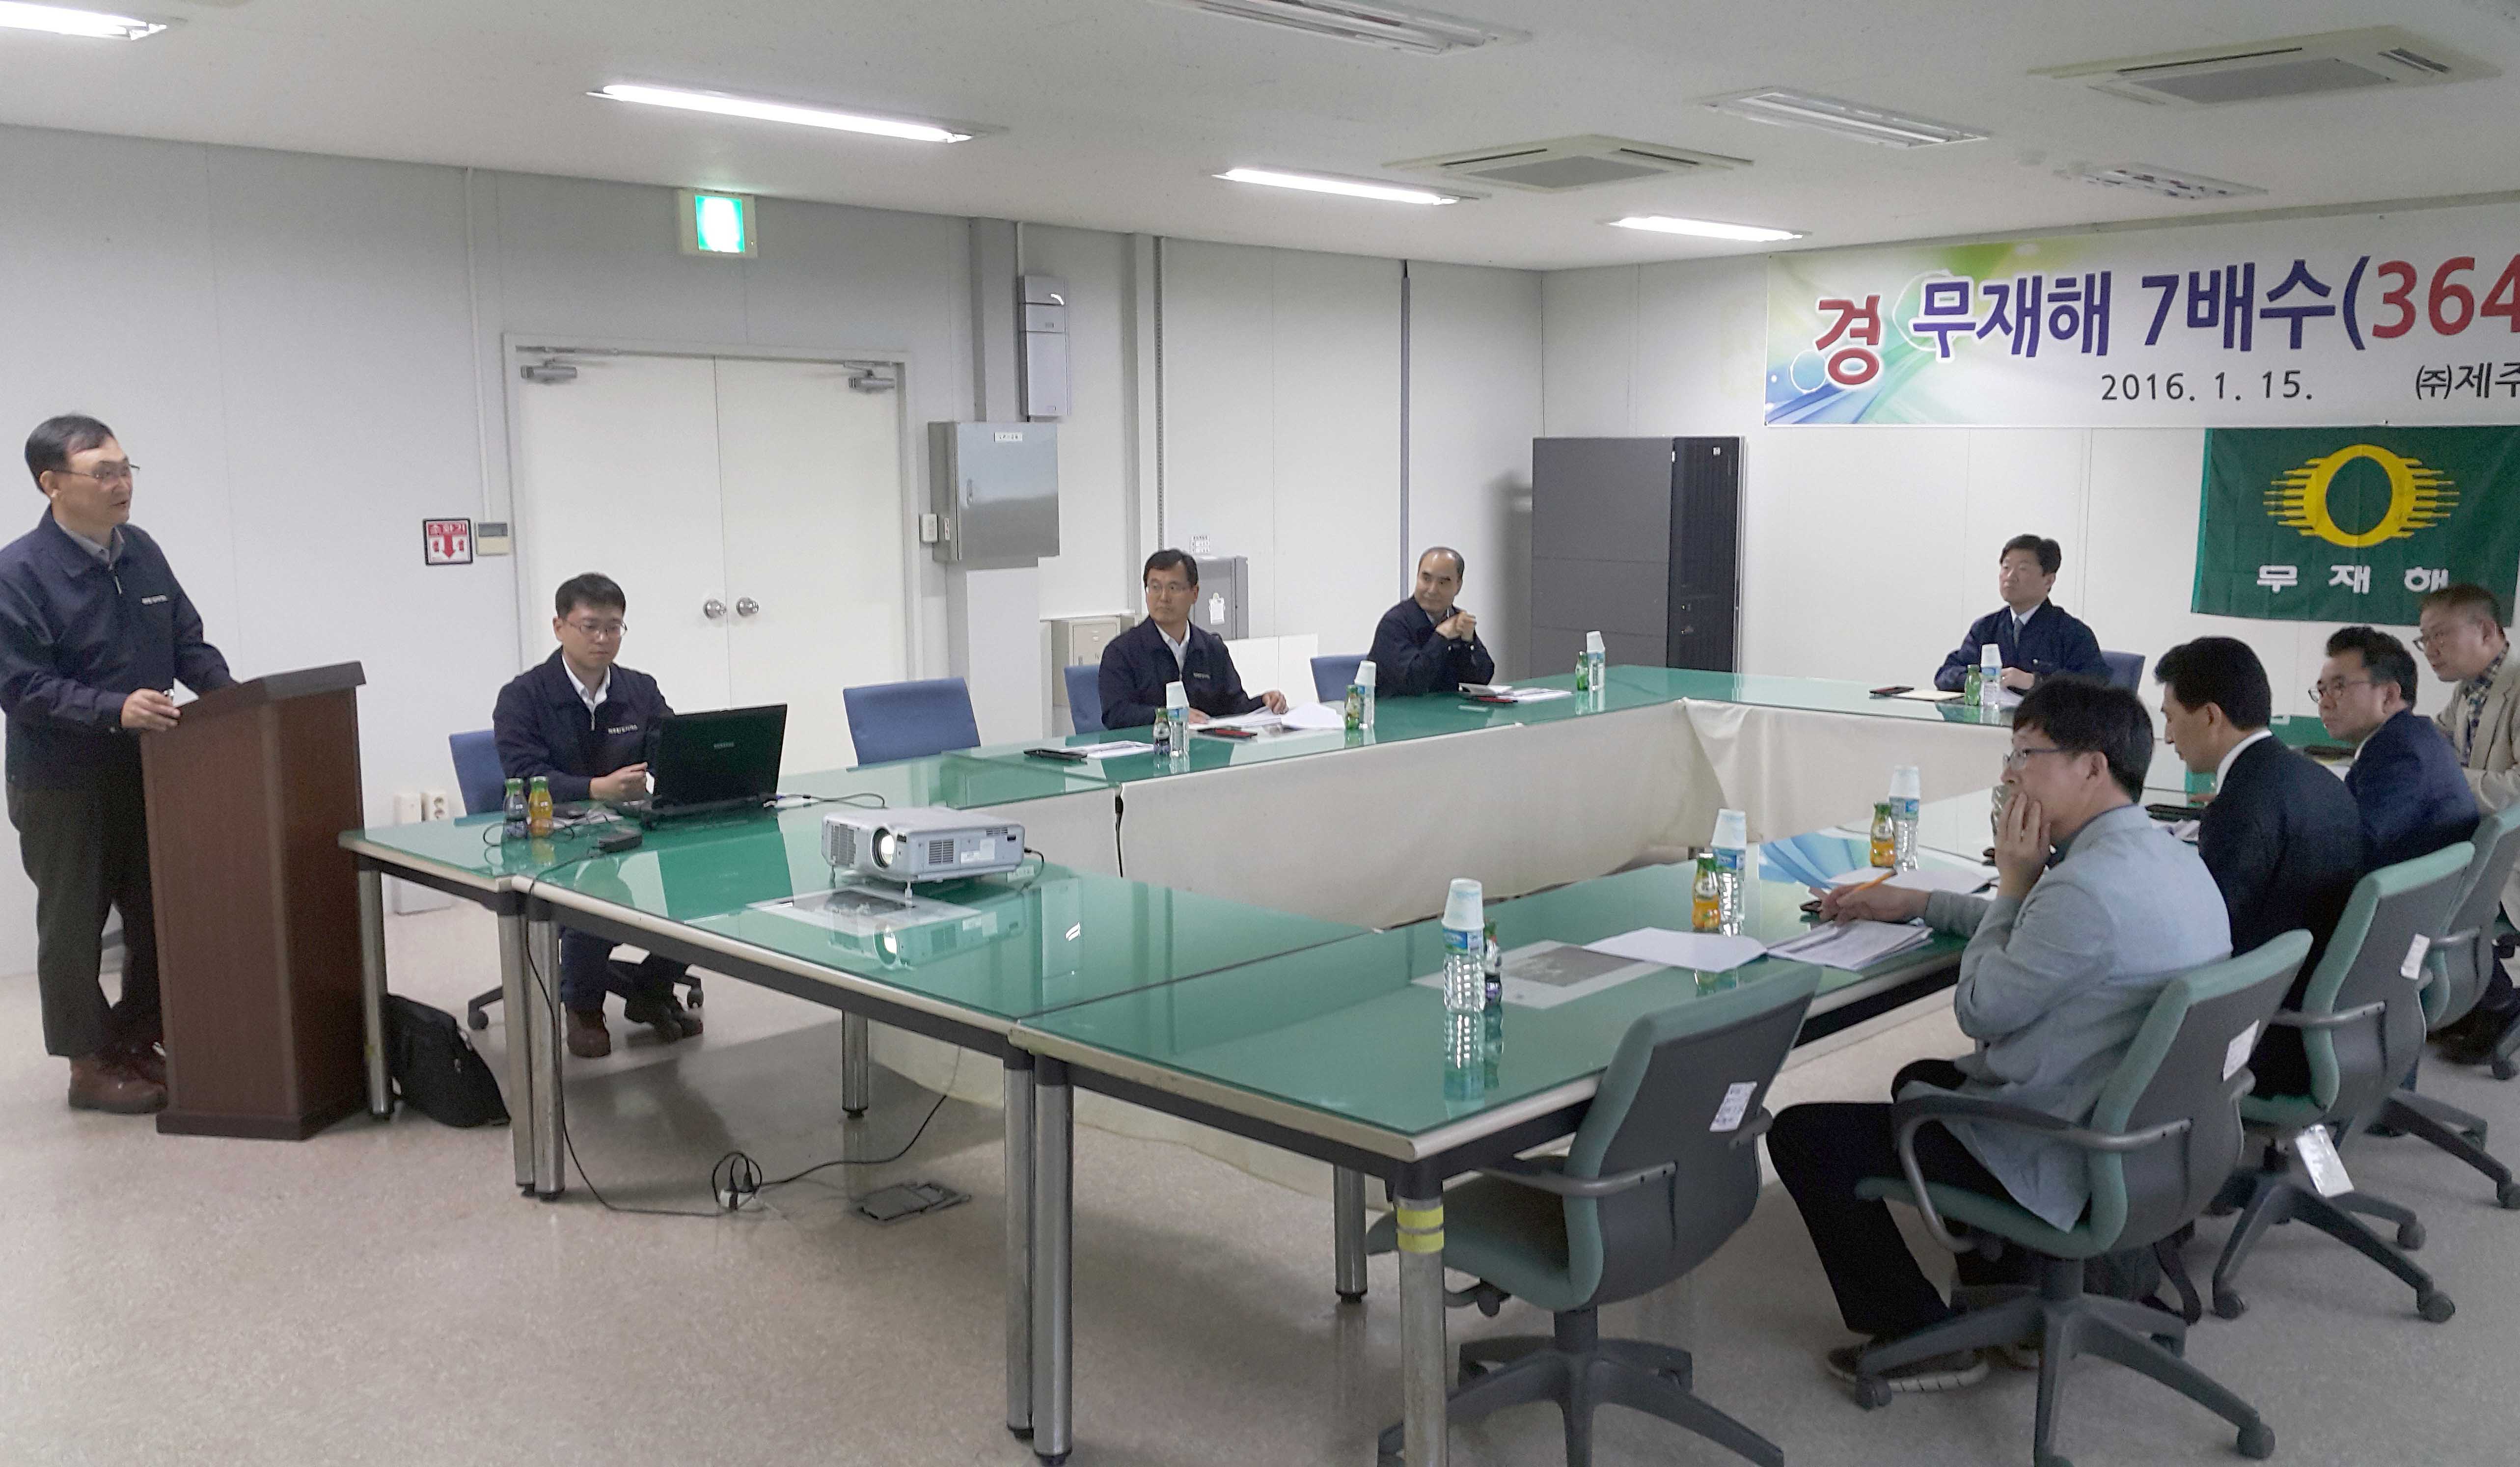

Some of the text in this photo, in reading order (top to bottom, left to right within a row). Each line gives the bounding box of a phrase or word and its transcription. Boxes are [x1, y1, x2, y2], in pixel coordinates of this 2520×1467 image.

[1816, 294, 1881, 385] 경
[1913, 270, 2112, 358] 무재해
[2101, 370, 2313, 401] 2016. 1. 15.
